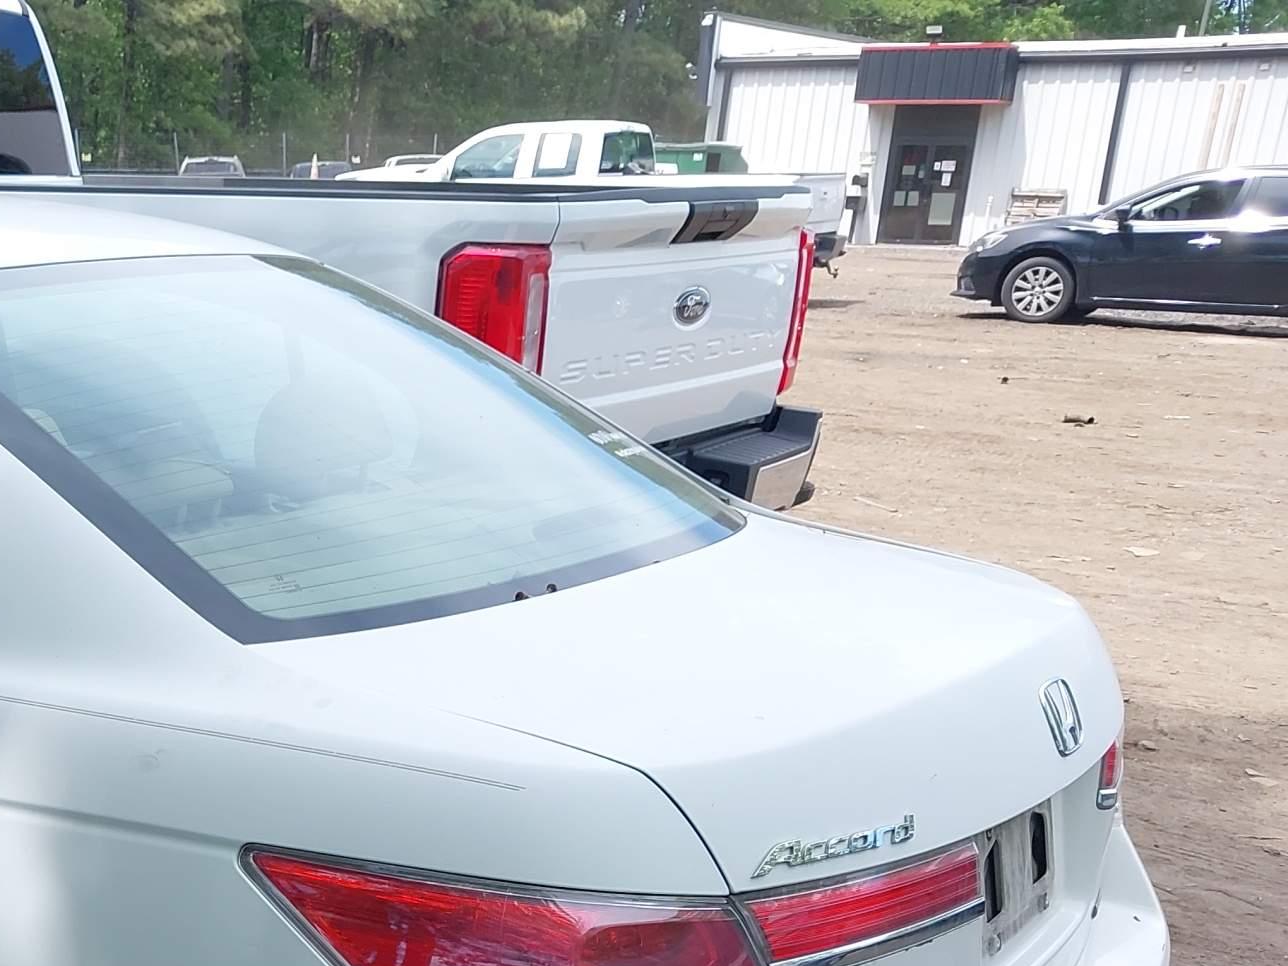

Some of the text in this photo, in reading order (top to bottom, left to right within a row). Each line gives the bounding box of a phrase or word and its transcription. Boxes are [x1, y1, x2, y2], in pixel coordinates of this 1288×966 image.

[559, 330, 785, 386] SUPER DUTY
[749, 813, 916, 880] Accord
